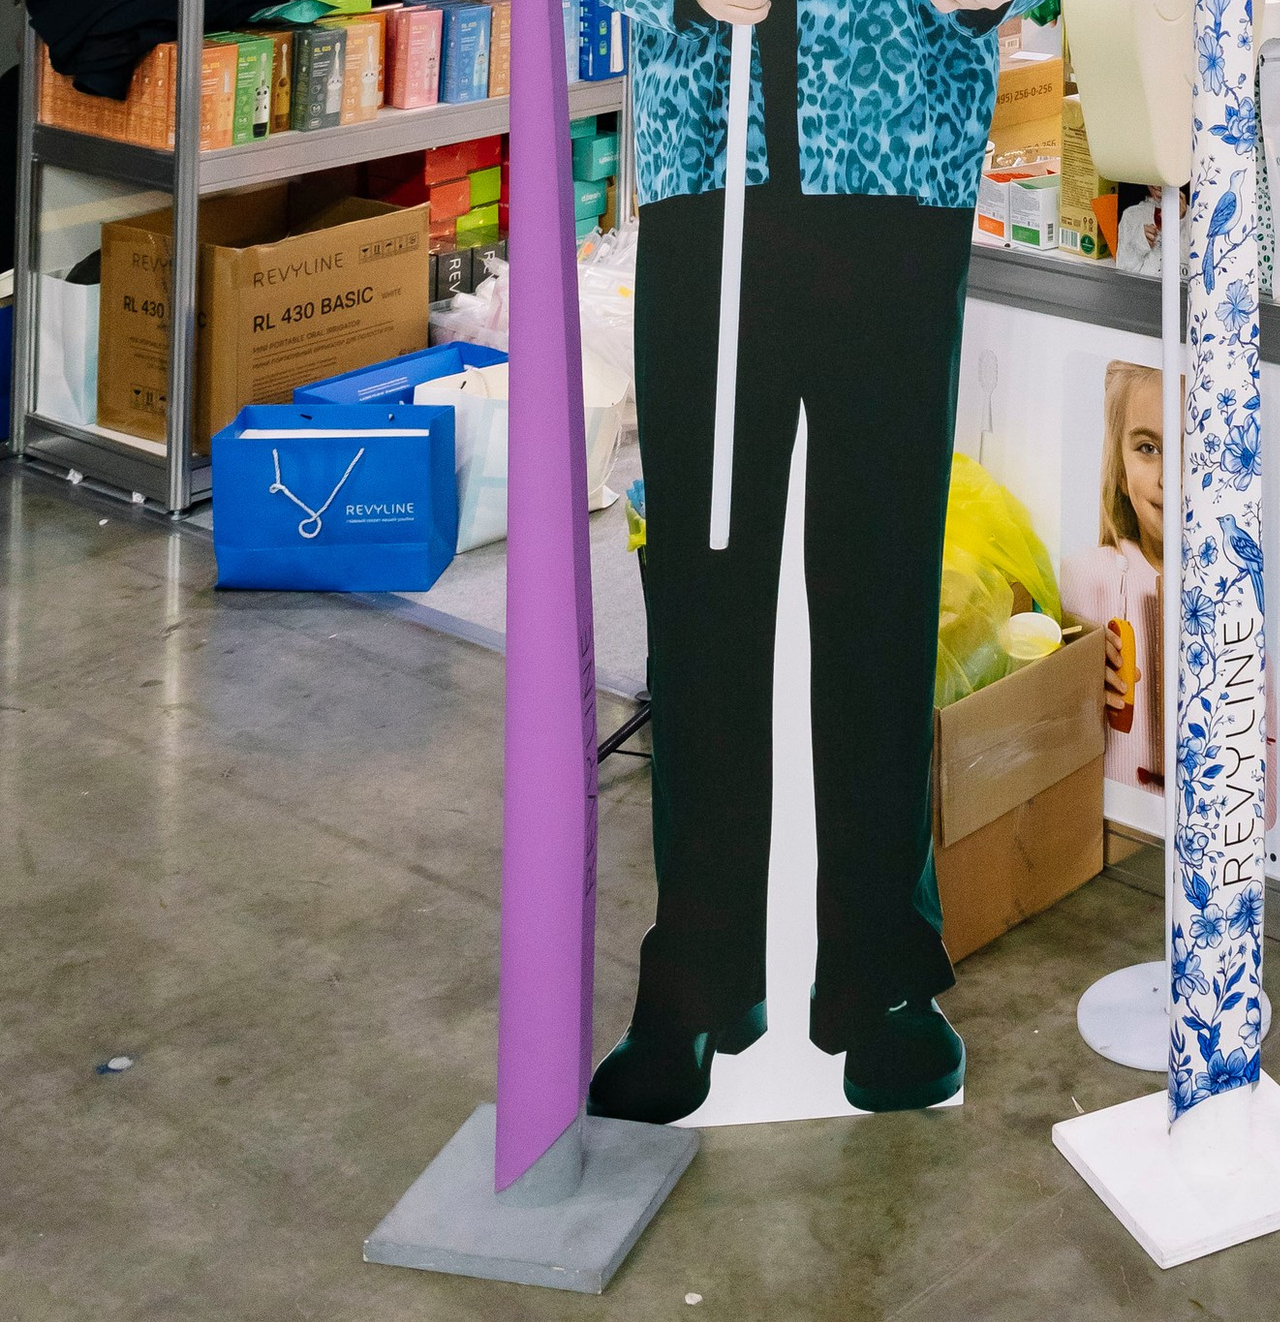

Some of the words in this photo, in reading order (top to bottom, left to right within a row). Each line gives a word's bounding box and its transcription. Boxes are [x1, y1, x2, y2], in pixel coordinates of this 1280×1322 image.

[1014, 84, 1053, 101] 256-0-256
[254, 252, 344, 289] REVYLINE
[123, 295, 138, 312] RL
[141, 302, 165, 319] 430
[253, 312, 276, 333] RL
[281, 302, 315, 326] 430
[320, 286, 374, 316] BASIC
[346, 502, 415, 516] REVYLINE
[1221, 616, 1255, 887] REVYLINE
